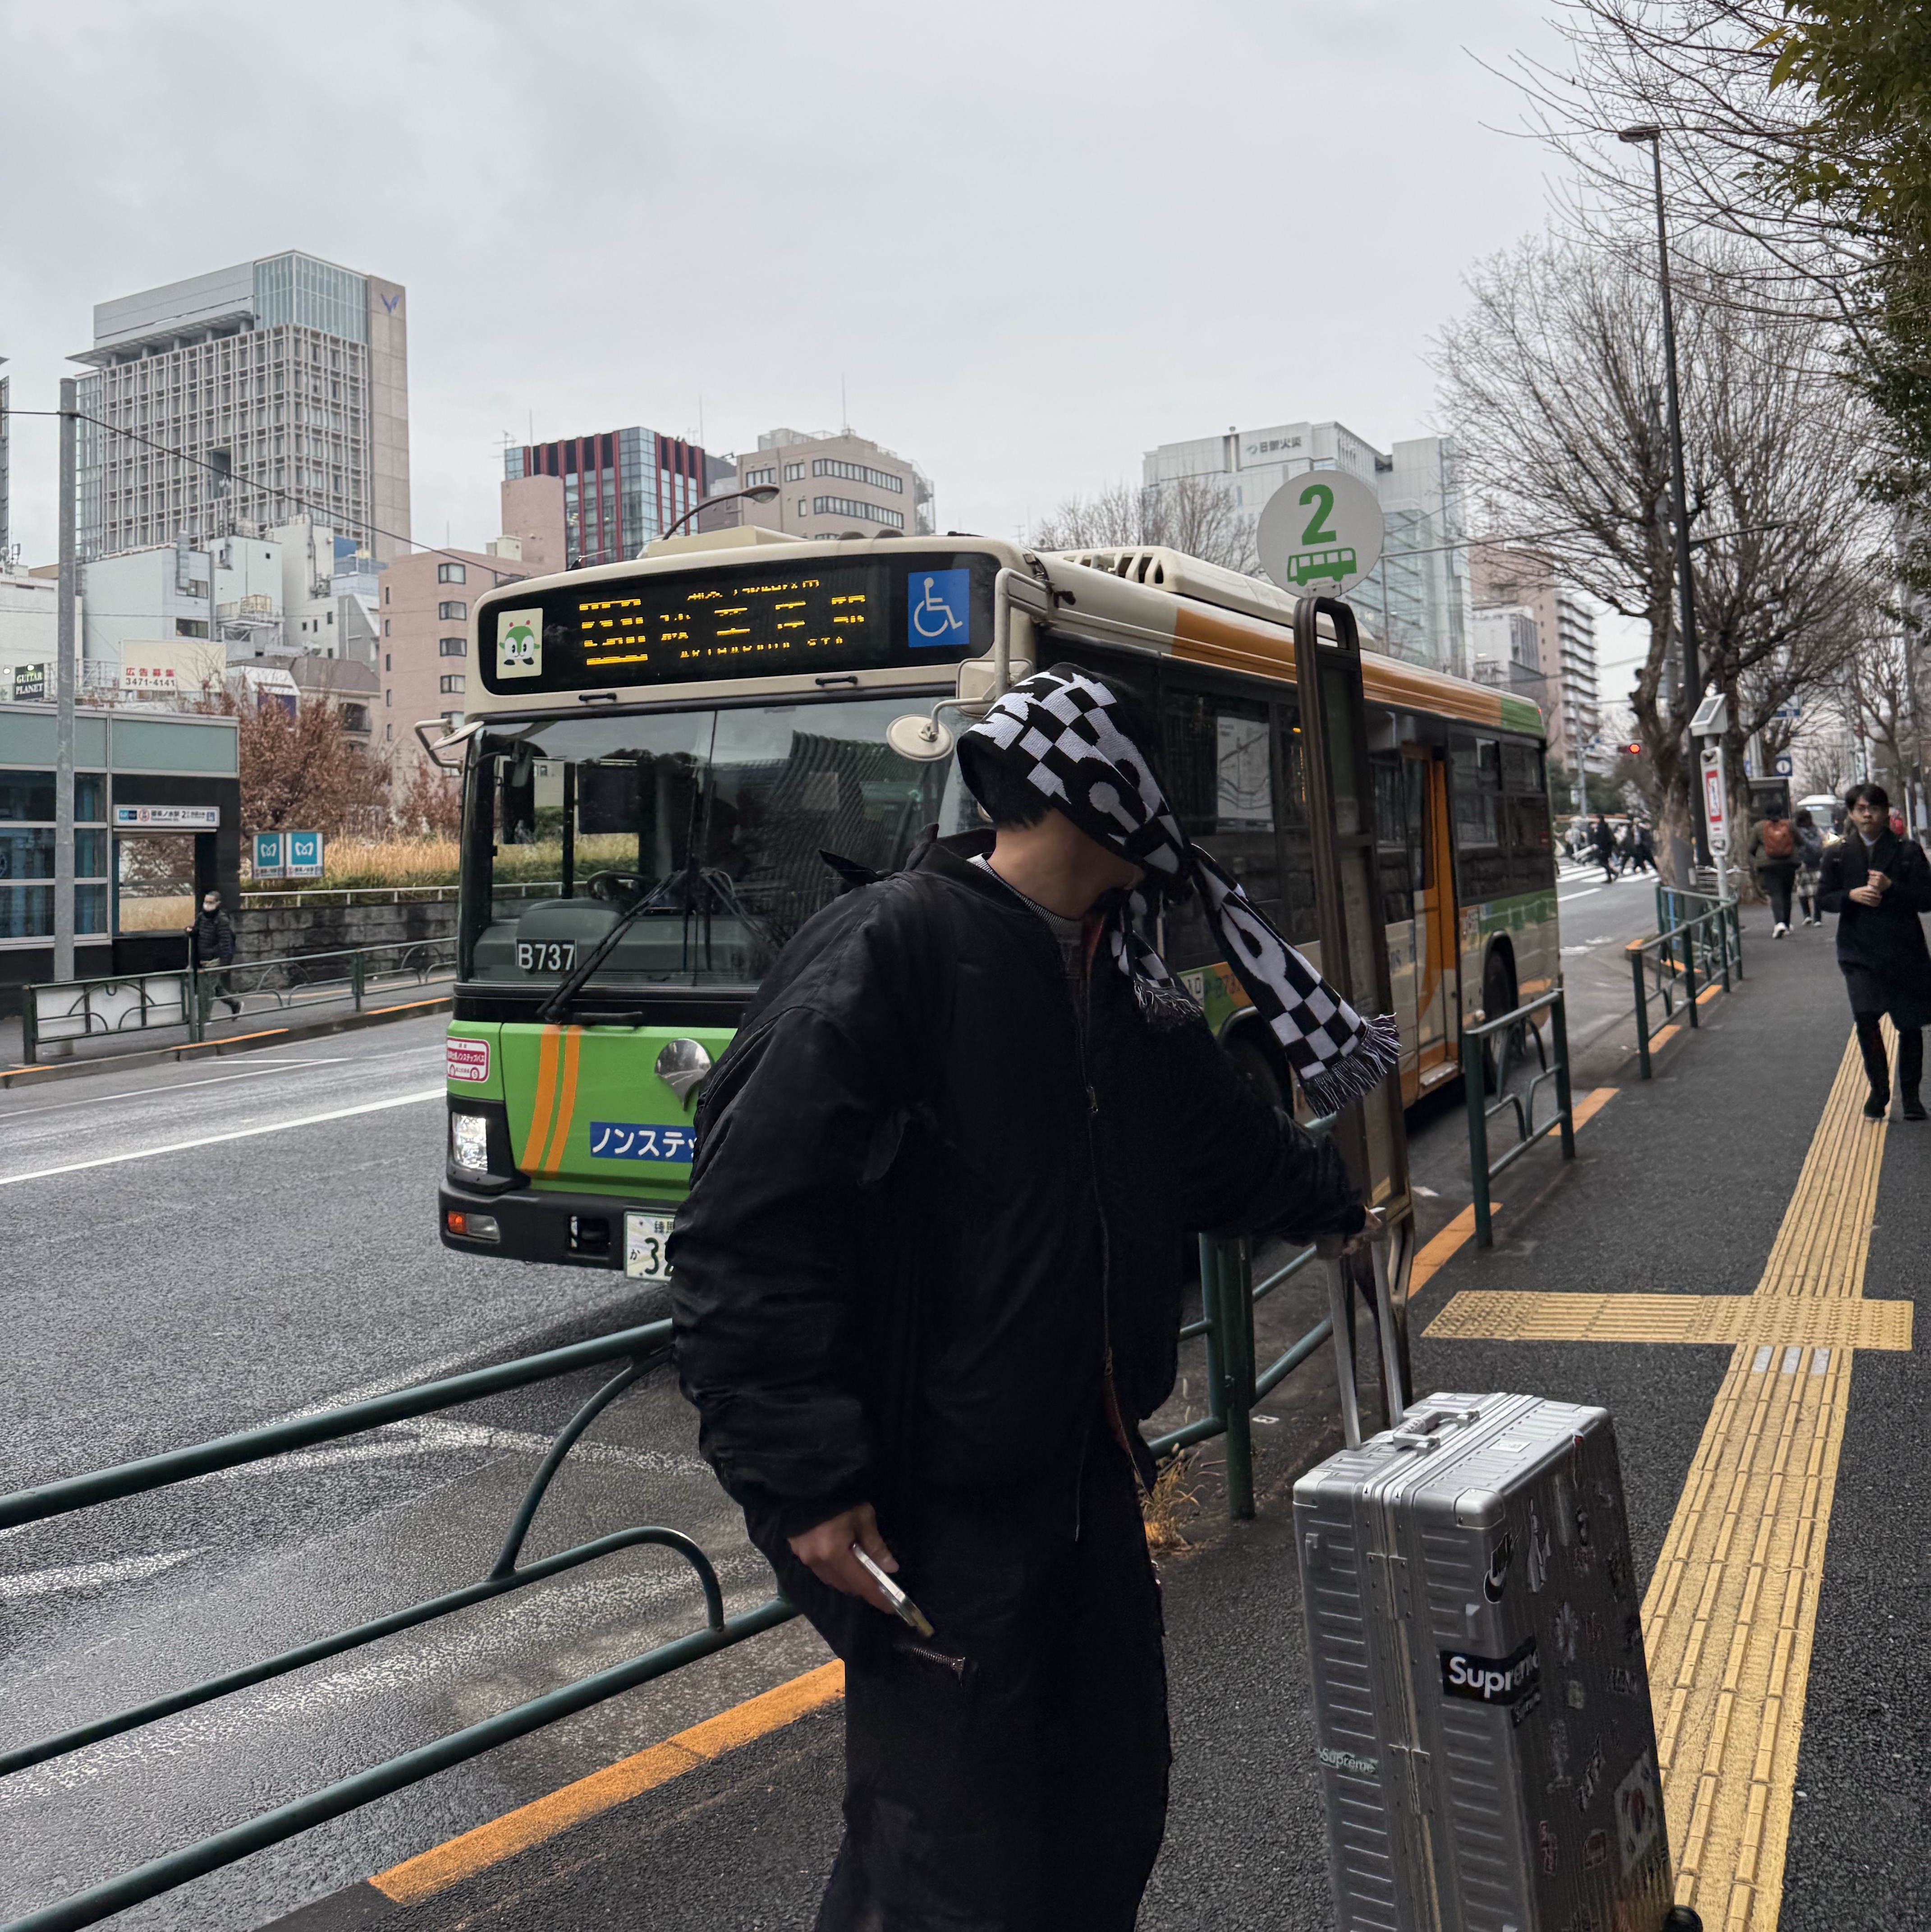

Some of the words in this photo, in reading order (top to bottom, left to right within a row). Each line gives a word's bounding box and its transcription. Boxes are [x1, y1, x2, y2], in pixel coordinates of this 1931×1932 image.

[1299, 484, 1337, 546] 2
[17, 672, 42, 684] GUITAR
[126, 678, 175, 686] 3471-4141
[16, 683, 43, 695] PLANET
[518, 943, 575, 972] B737
[1320, 1747, 1376, 1775] Supreme
